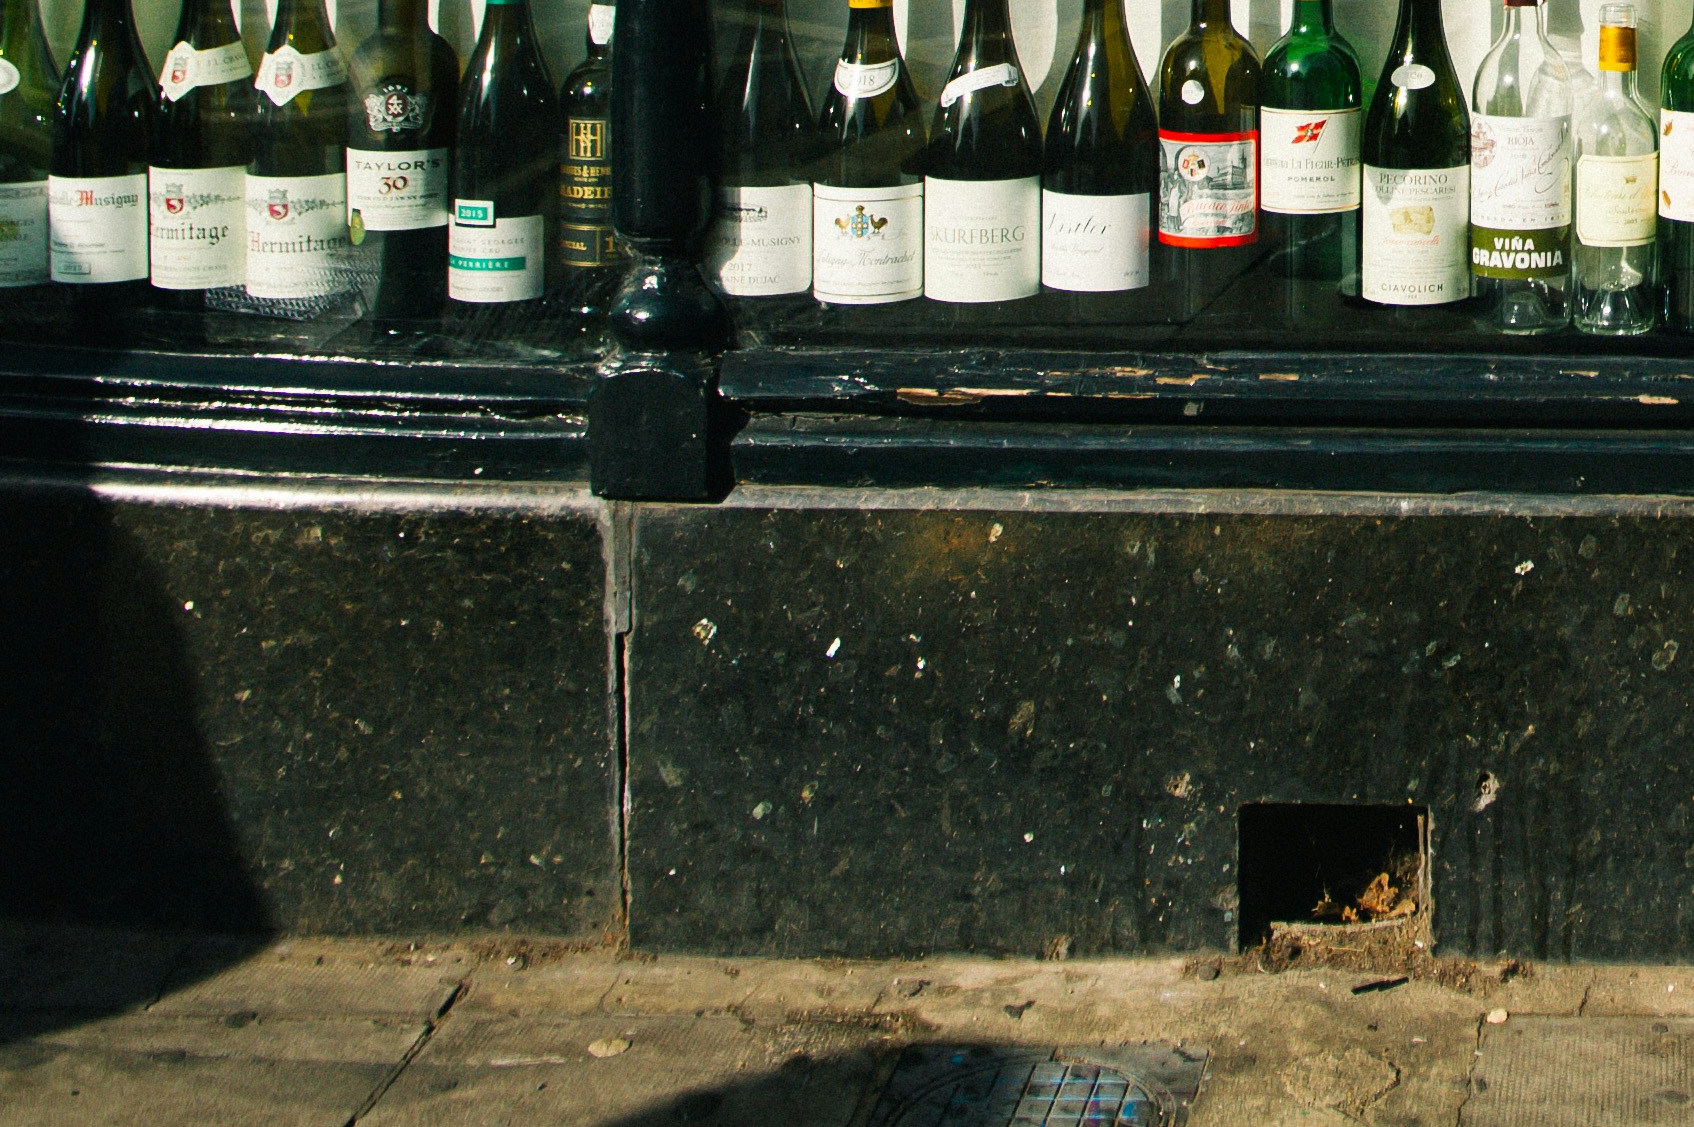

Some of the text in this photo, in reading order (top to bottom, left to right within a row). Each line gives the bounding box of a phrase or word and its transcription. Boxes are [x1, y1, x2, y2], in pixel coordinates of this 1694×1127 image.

[1507, 136, 1535, 146] RIOJA
[355, 158, 441, 172] TAYLOR'S
[378, 175, 408, 195] 30
[1287, 175, 1336, 183] POMEROL
[1379, 172, 1448, 185] PECORINO
[76, 190, 139, 209] Musigny
[1493, 235, 1535, 251] VIÑA
[1472, 246, 1563, 270] GRAVONIA
[748, 275, 780, 285] DUJAC
[1380, 282, 1444, 293] CIAVOLICH
